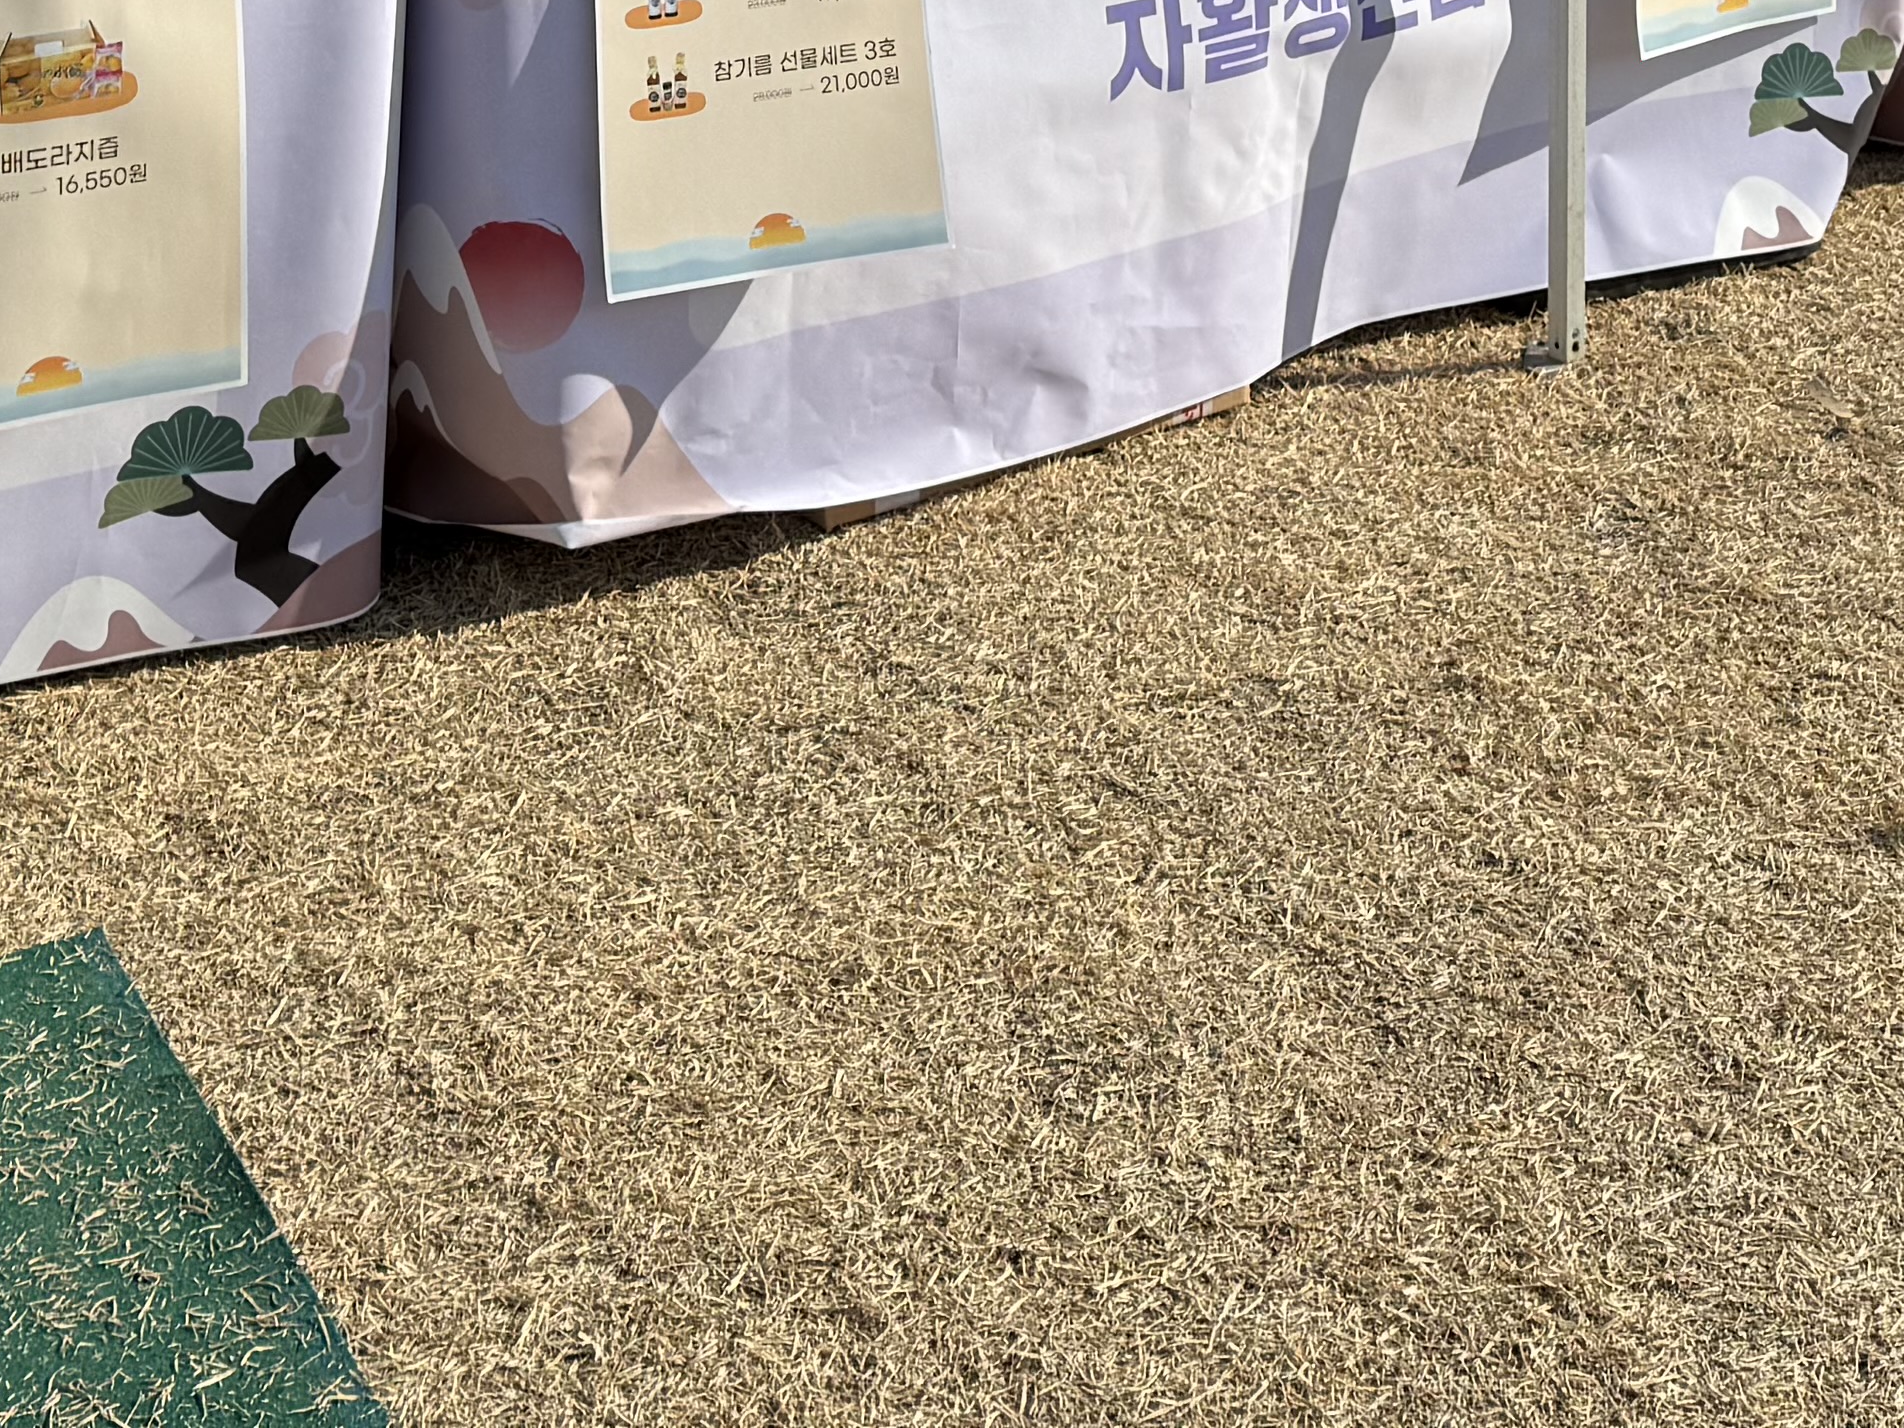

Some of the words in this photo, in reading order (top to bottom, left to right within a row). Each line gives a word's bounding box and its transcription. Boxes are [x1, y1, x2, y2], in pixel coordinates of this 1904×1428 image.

[713, 53, 773, 82] 참기름
[780, 42, 859, 74] 선물세트
[863, 36, 897, 61] 3호
[819, 65, 900, 95] 21,000원
[1, 135, 119, 175] 배도라지즙
[55, 162, 148, 196] 16,550원
